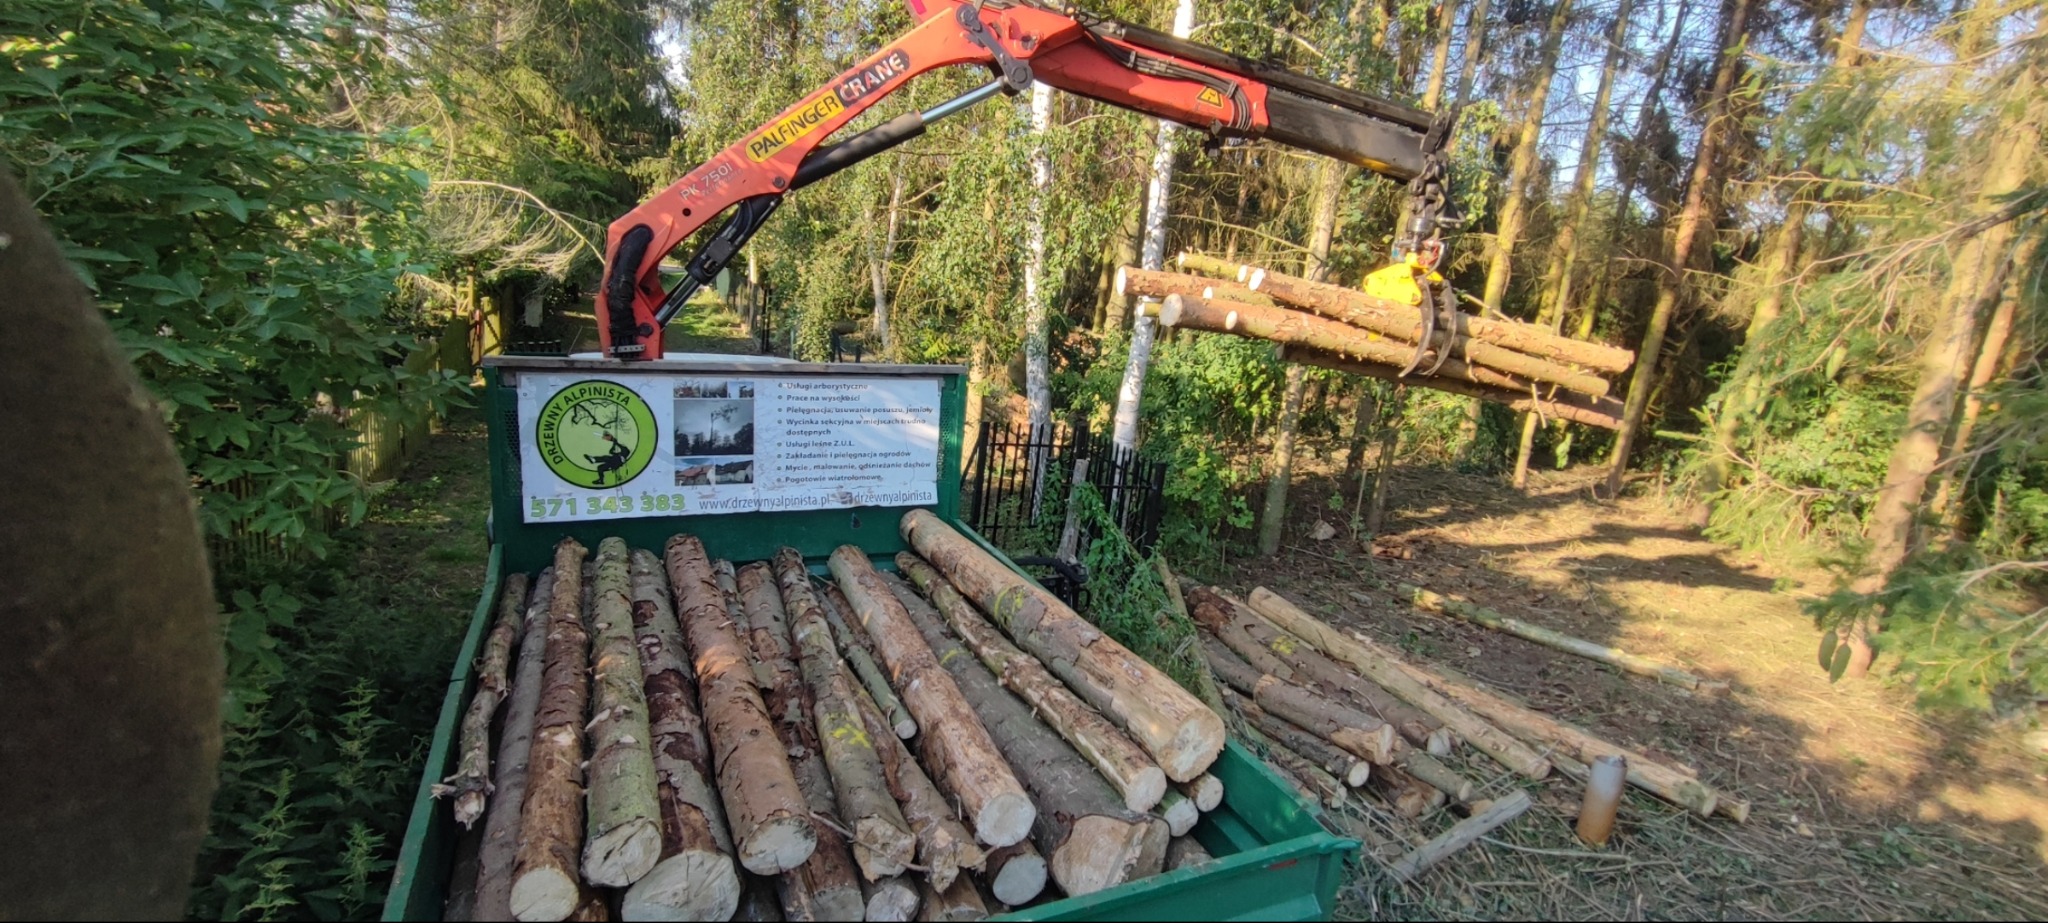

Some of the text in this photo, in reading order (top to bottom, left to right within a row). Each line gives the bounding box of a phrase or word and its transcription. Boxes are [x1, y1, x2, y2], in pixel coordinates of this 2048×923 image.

[750, 53, 904, 158] PALFINGER CRANE
[680, 184, 700, 201] PK
[786, 382, 868, 391] Usługi arborystyczne
[821, 394, 860, 402] wysokości
[906, 406, 933, 414] jemioły
[543, 386, 630, 465] DRZEWNY ALPINISTA
[786, 418, 819, 426] Wycinka
[821, 418, 854, 426] sekcyjna
[863, 418, 900, 426] miejscach
[786, 428, 831, 436] dostępnych
[786, 440, 810, 449] Usługi
[812, 440, 832, 448] leśne
[834, 451, 877, 459] pielęgnacja
[879, 450, 911, 458] ogrodów
[859, 462, 901, 470] odśnieżanie
[785, 476, 826, 484] Pogotowie
[699, 489, 932, 510] www.drzewnyalpinista.pl drzewnyalpinista
[531, 493, 685, 518] 571 343 383
